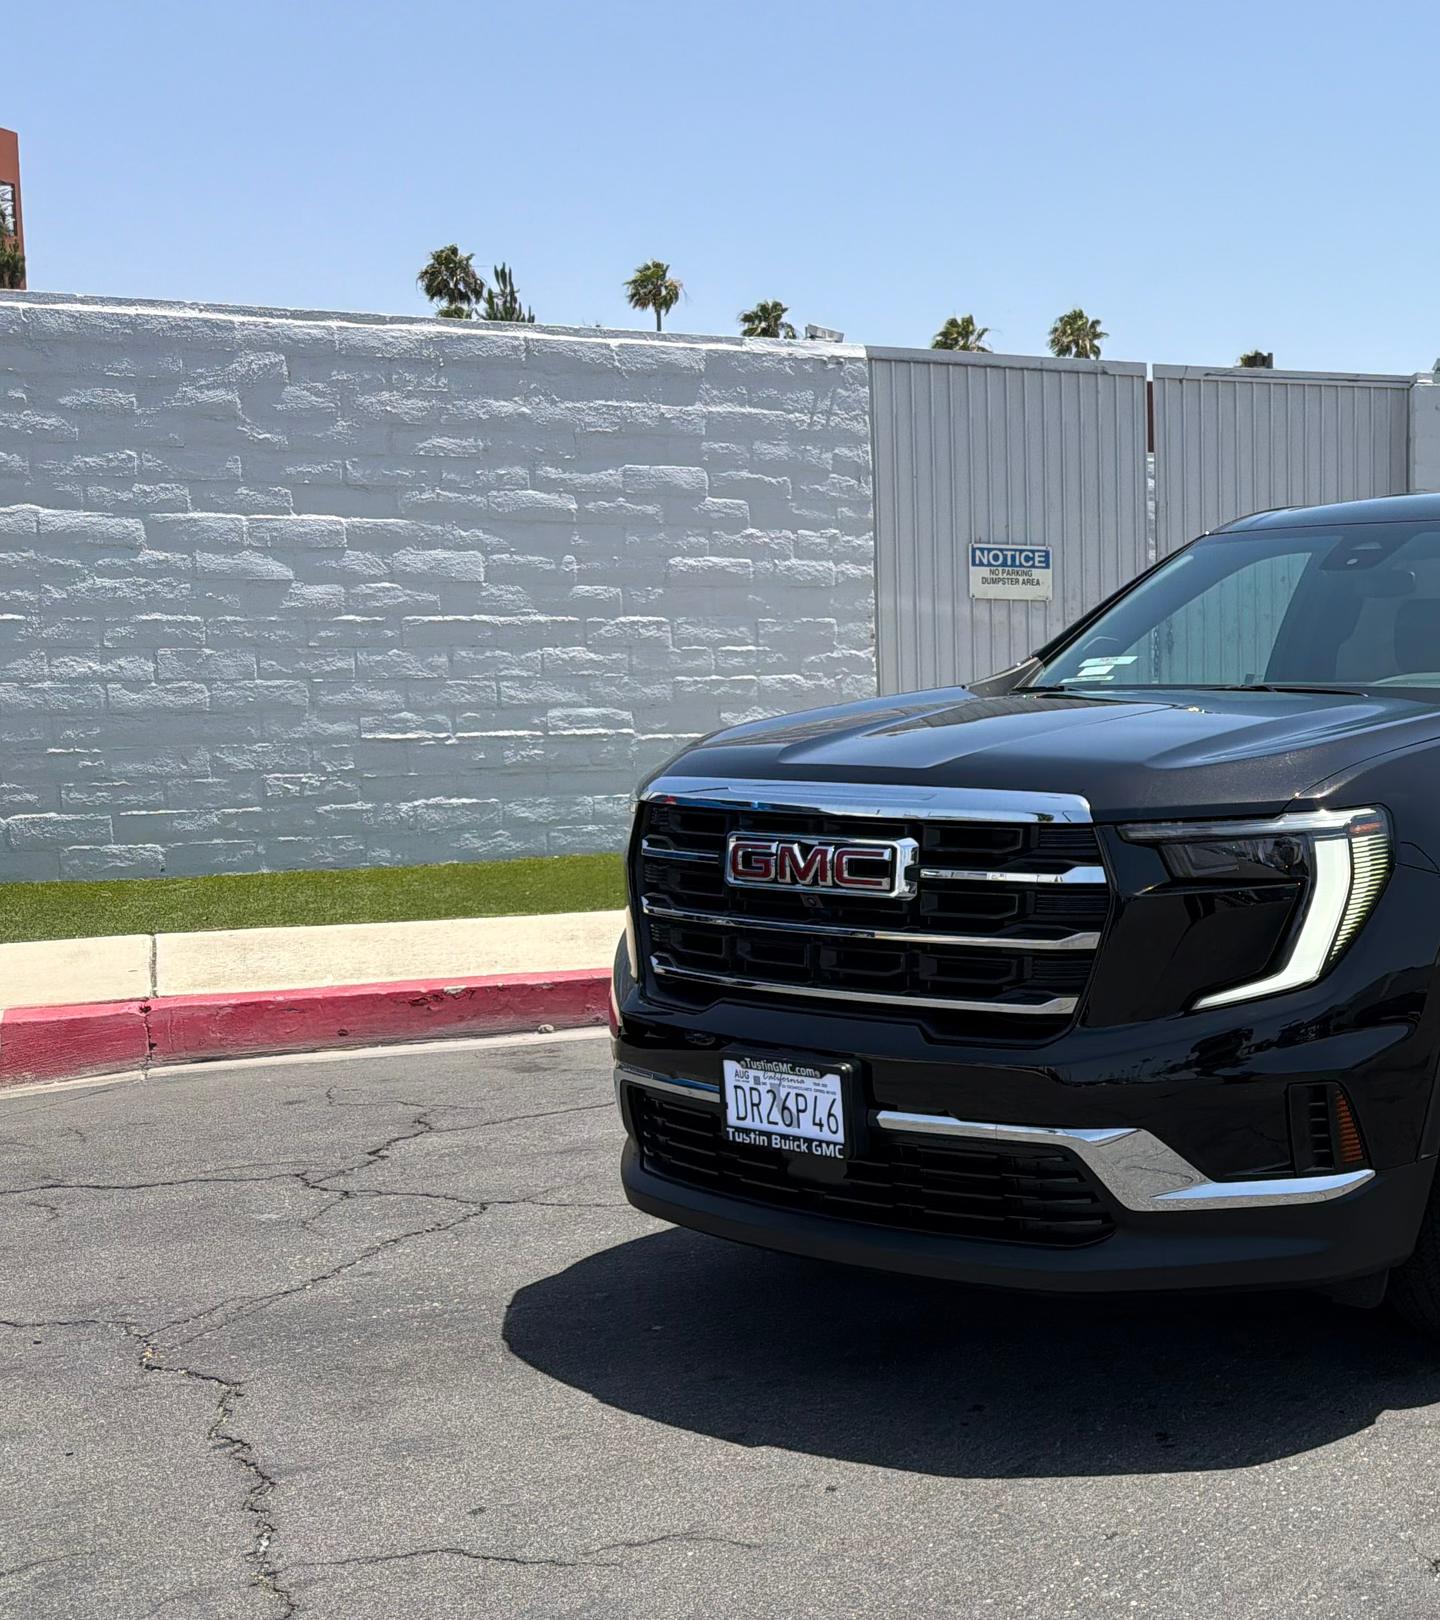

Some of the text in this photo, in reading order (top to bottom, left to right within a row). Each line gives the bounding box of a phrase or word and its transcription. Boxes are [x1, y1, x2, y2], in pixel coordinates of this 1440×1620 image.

[975, 549, 1046, 567] NOTICE
[981, 576, 1041, 587] DUMPSTER AREA
[989, 568, 1033, 578] NO PARKING
[731, 841, 892, 891] GMC
[734, 1069, 750, 1080] AUG
[744, 1057, 816, 1077] TustinGMC.com
[733, 1085, 839, 1135] DR26P46
[726, 1127, 844, 1159] Tustin Buick GMC
